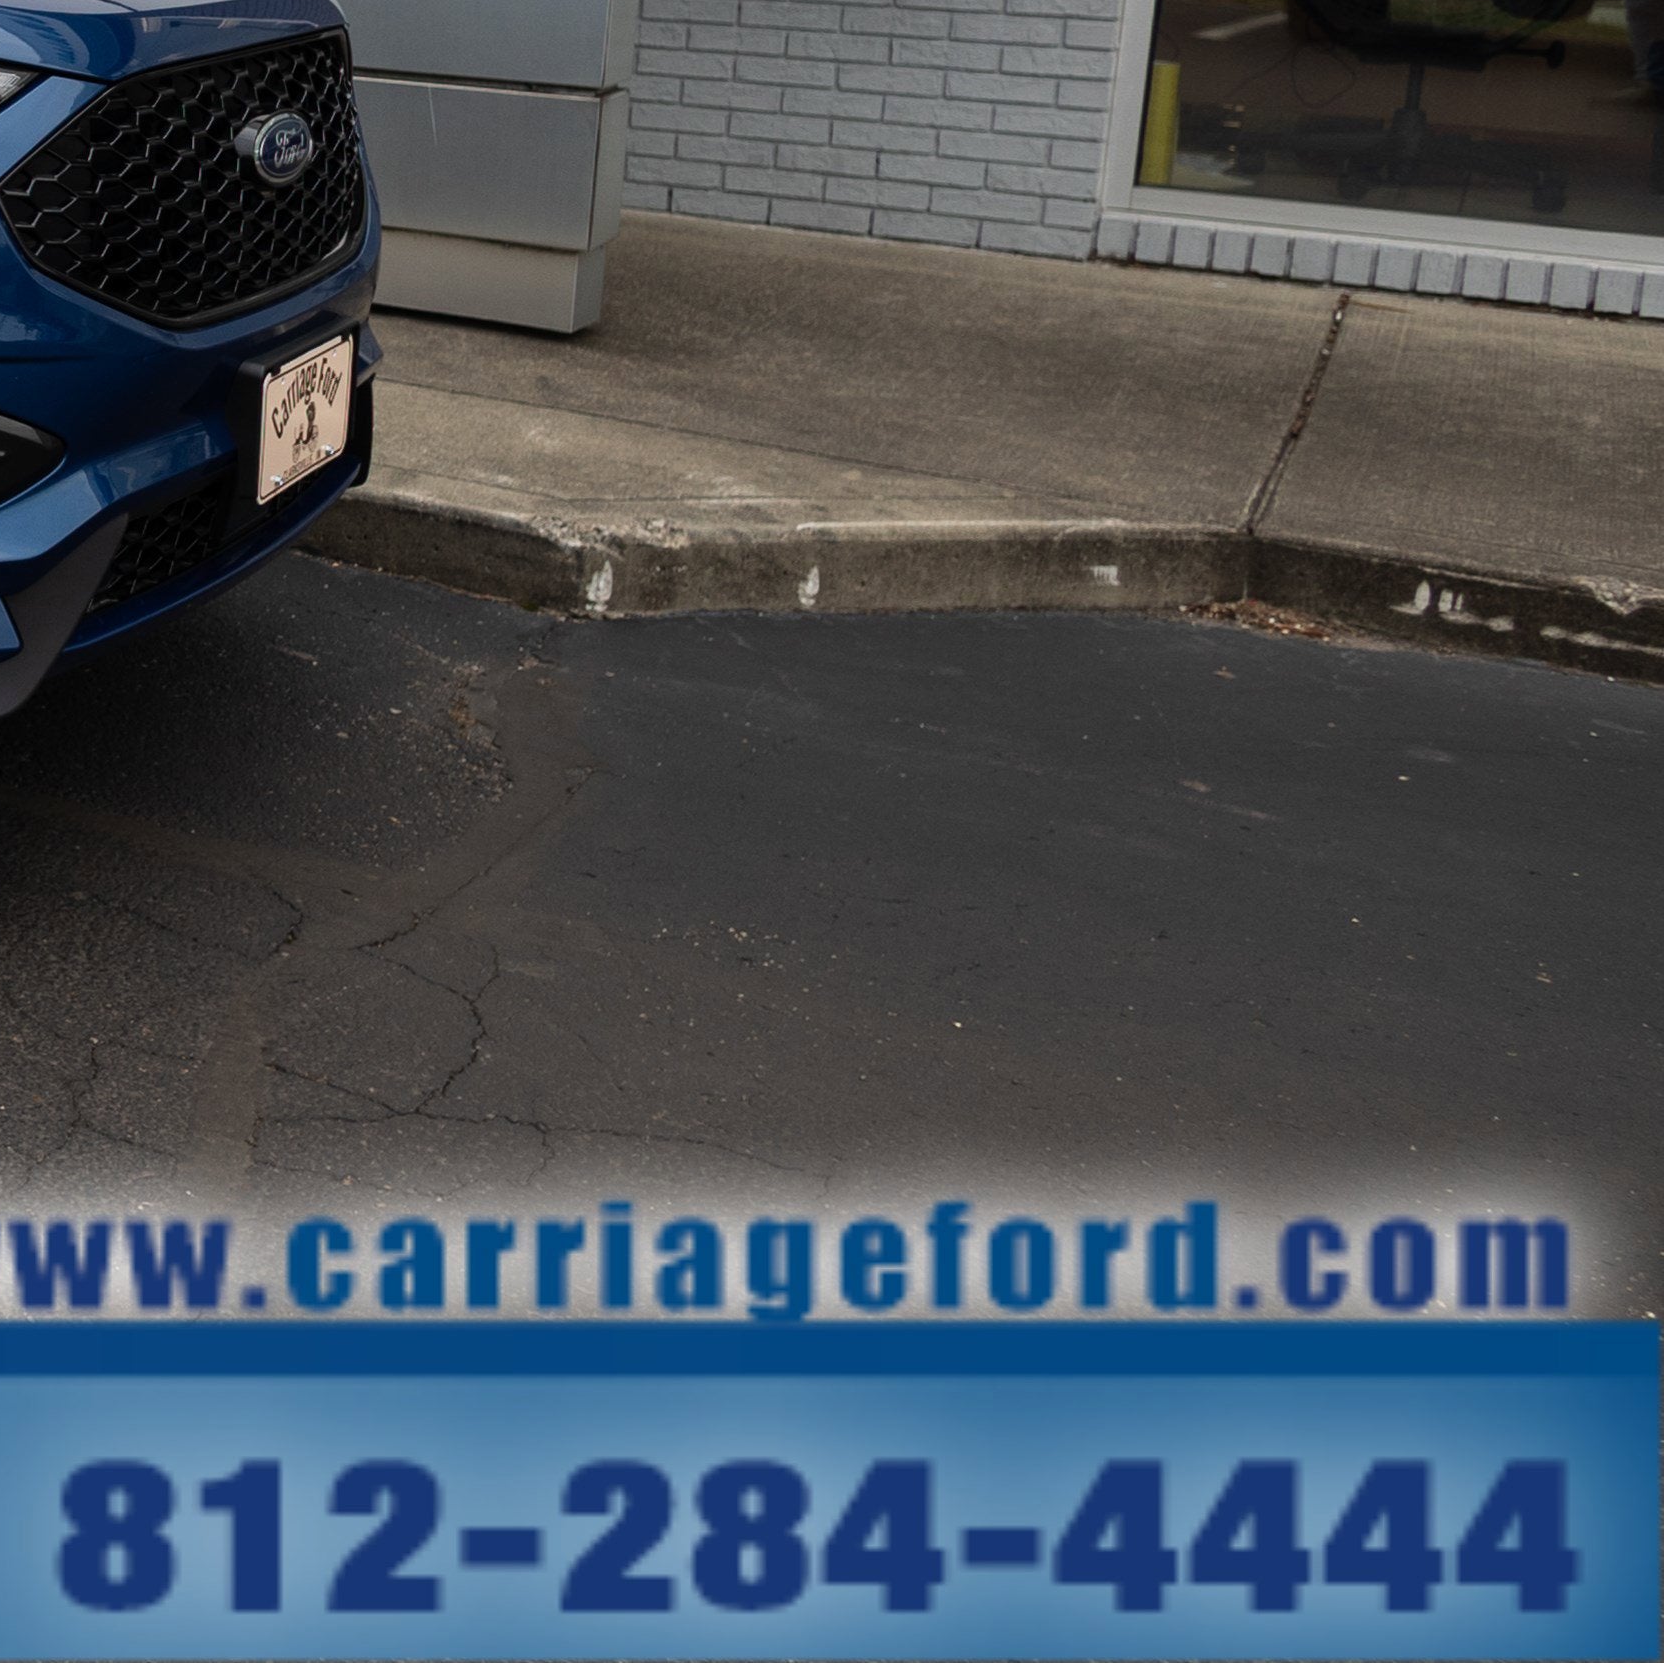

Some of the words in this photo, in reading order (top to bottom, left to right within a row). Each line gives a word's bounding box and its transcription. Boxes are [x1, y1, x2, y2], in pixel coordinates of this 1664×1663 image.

[273, 129, 305, 169] Ford
[271, 362, 318, 439] Carriage
[316, 357, 343, 408] Ford
